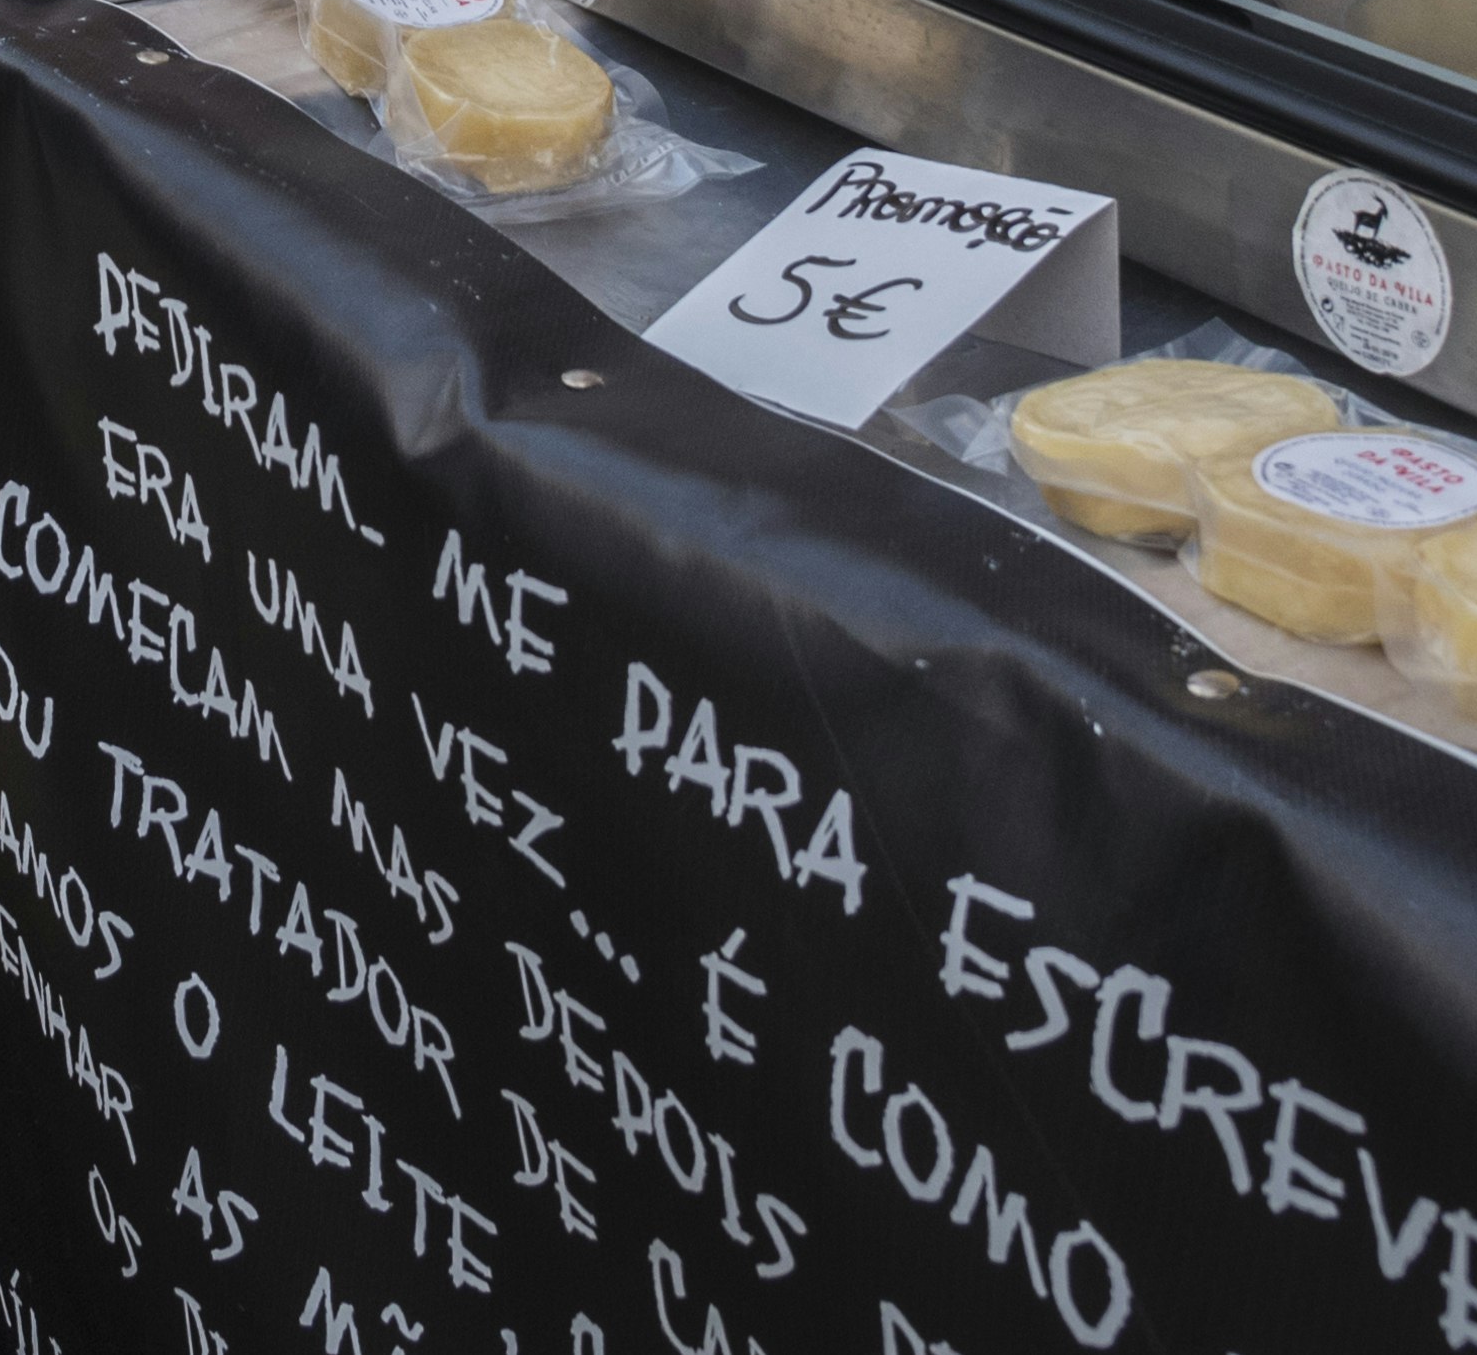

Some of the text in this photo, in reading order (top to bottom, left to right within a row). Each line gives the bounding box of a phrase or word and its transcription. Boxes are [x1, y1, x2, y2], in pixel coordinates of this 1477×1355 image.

[728, 254, 924, 341] 5€
[1312, 254, 1434, 307] PASTO DA VILA
[98, 417, 212, 561] ERA
[248, 550, 374, 717] UMA
[702, 929, 766, 1065] É
[831, 1027, 1131, 1347] COMO
[433, 529, 569, 674] ME
[615, 662, 867, 914] PARA
[98, 741, 462, 1119] TRATADOR
[501, 1088, 598, 1241] DE
[174, 972, 220, 1059] O
[268, 1044, 498, 1293] LEITE
[331, 768, 459, 944] MAS
[505, 942, 806, 1279] DEPOIS
[88, 1165, 142, 1278] OS
[172, 1146, 259, 1261] AS
